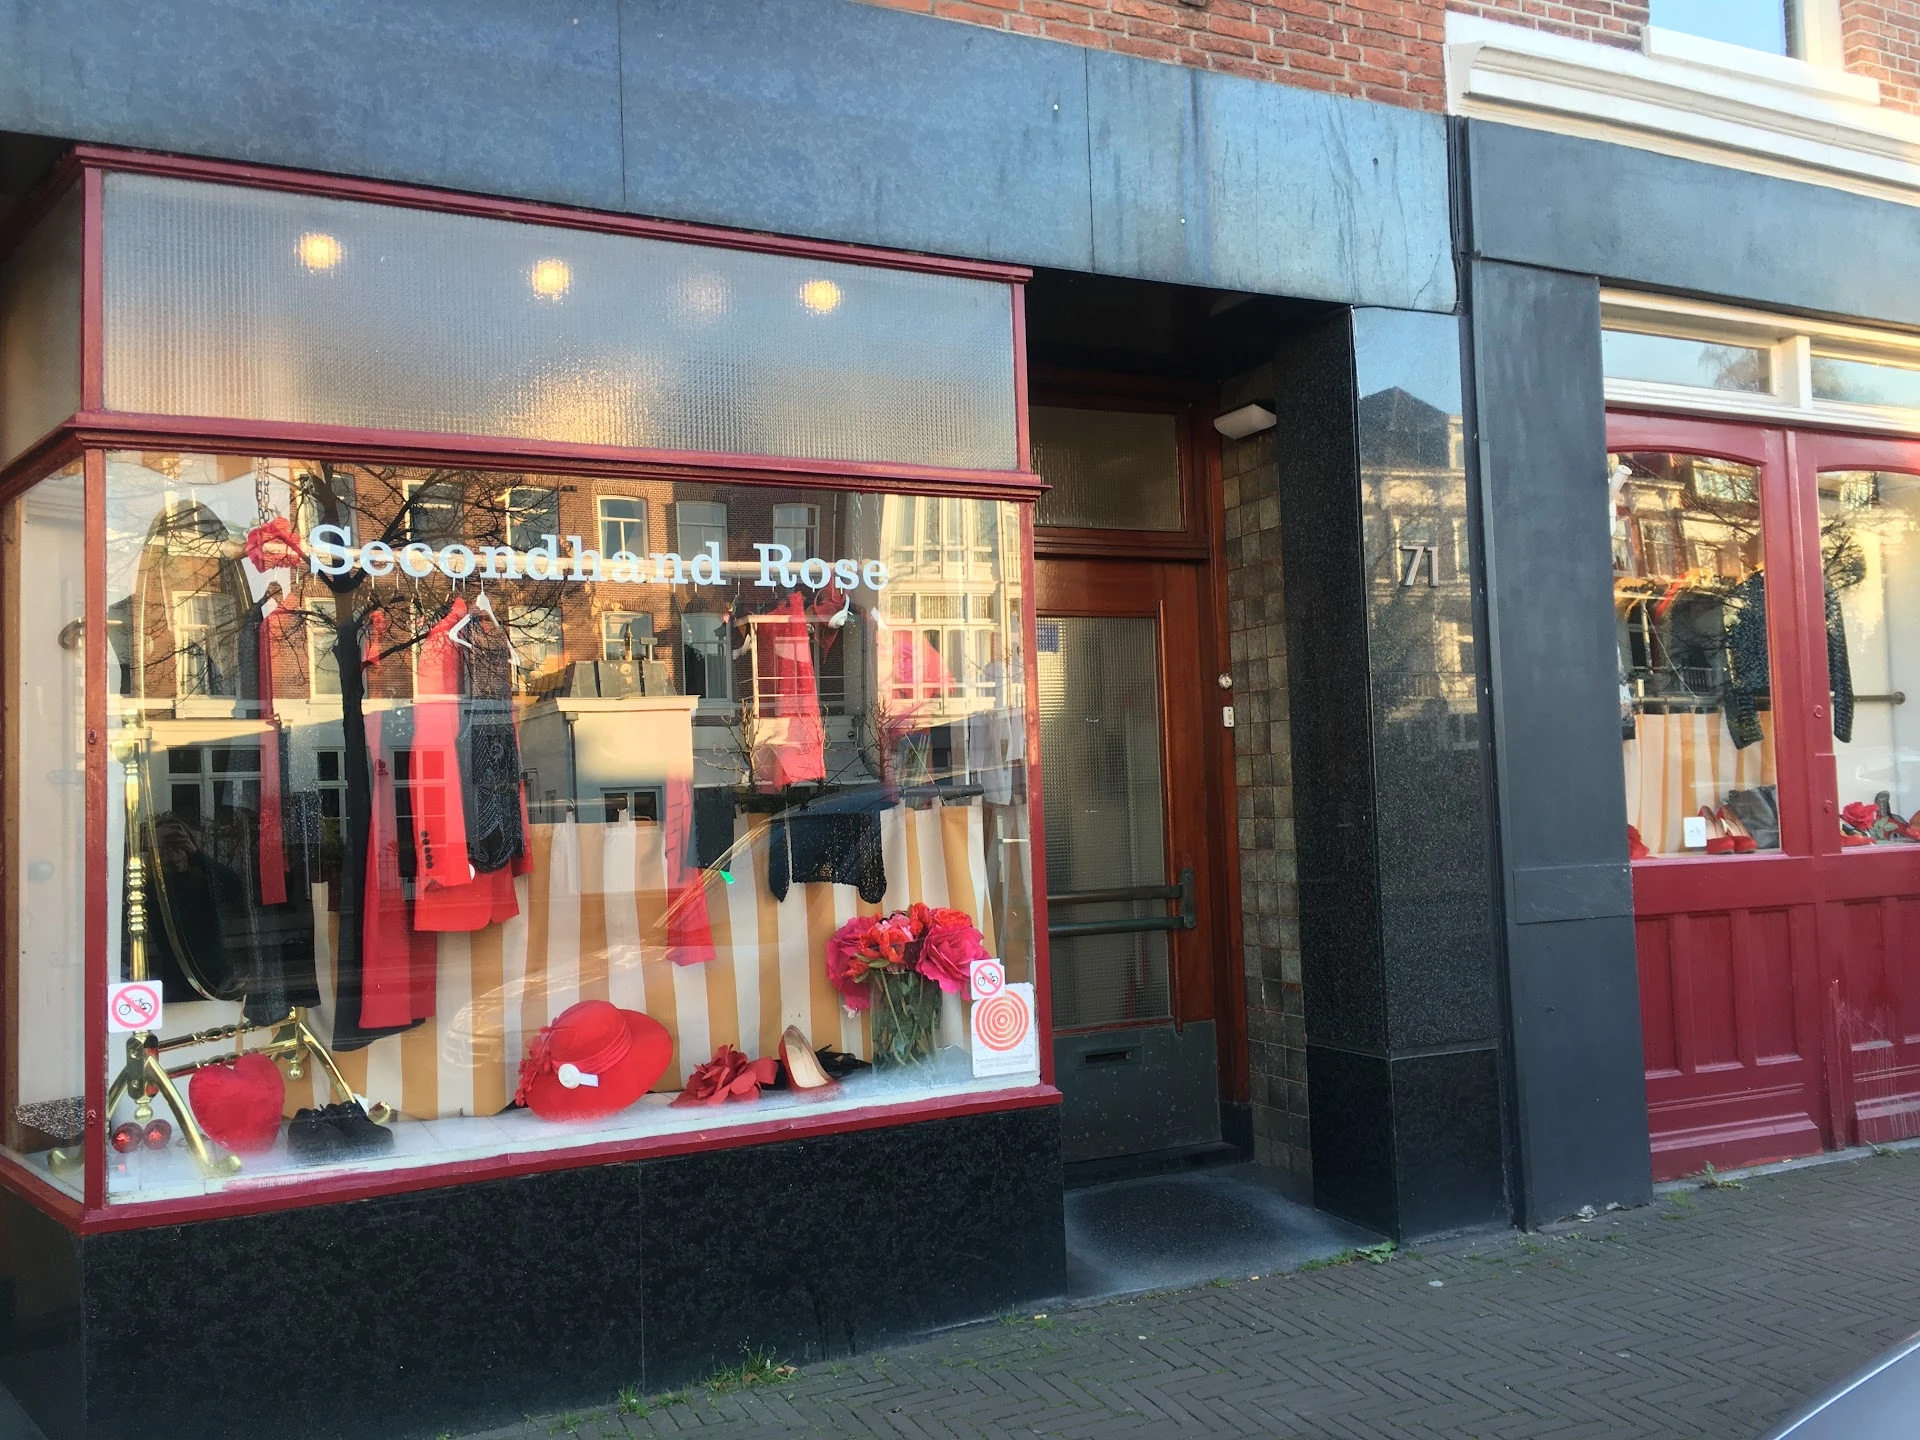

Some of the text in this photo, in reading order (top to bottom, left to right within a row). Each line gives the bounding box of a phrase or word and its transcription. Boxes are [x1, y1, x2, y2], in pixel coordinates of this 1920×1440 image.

[309, 524, 889, 591] Secondhand Rose
[1400, 545, 1439, 587] 71
